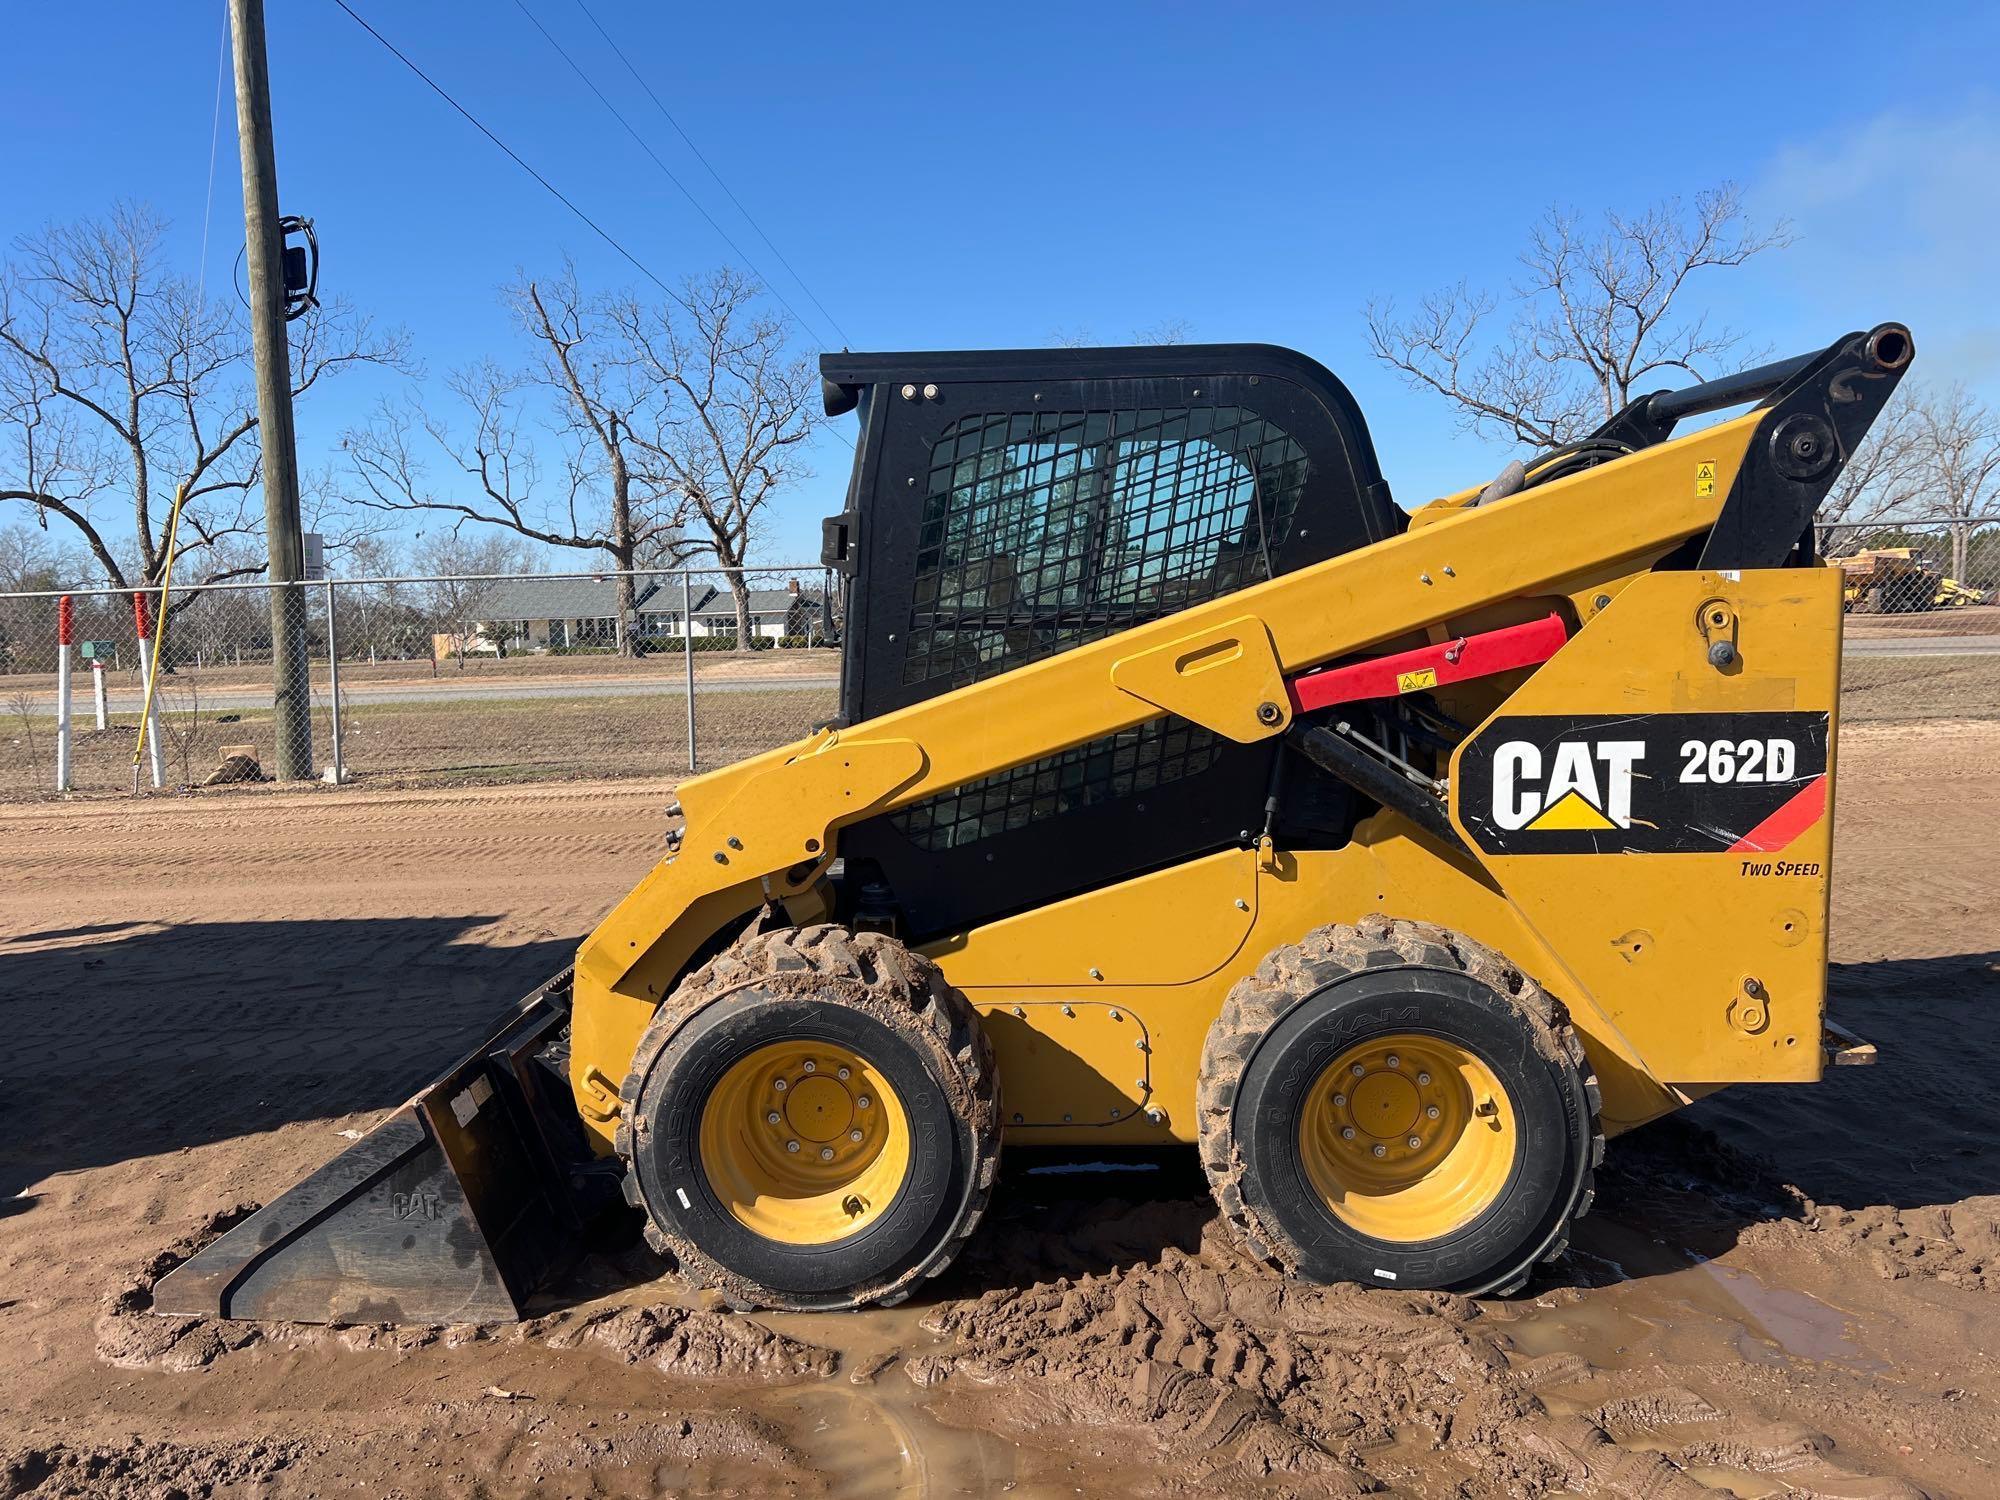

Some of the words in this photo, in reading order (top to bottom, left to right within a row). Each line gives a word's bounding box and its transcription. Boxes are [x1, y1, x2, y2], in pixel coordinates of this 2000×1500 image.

[1493, 740, 1646, 830] CAT
[1679, 738, 1796, 784] 262D
[1280, 1006, 1423, 1097] MAXAM
[393, 1192, 440, 1222] CAT
